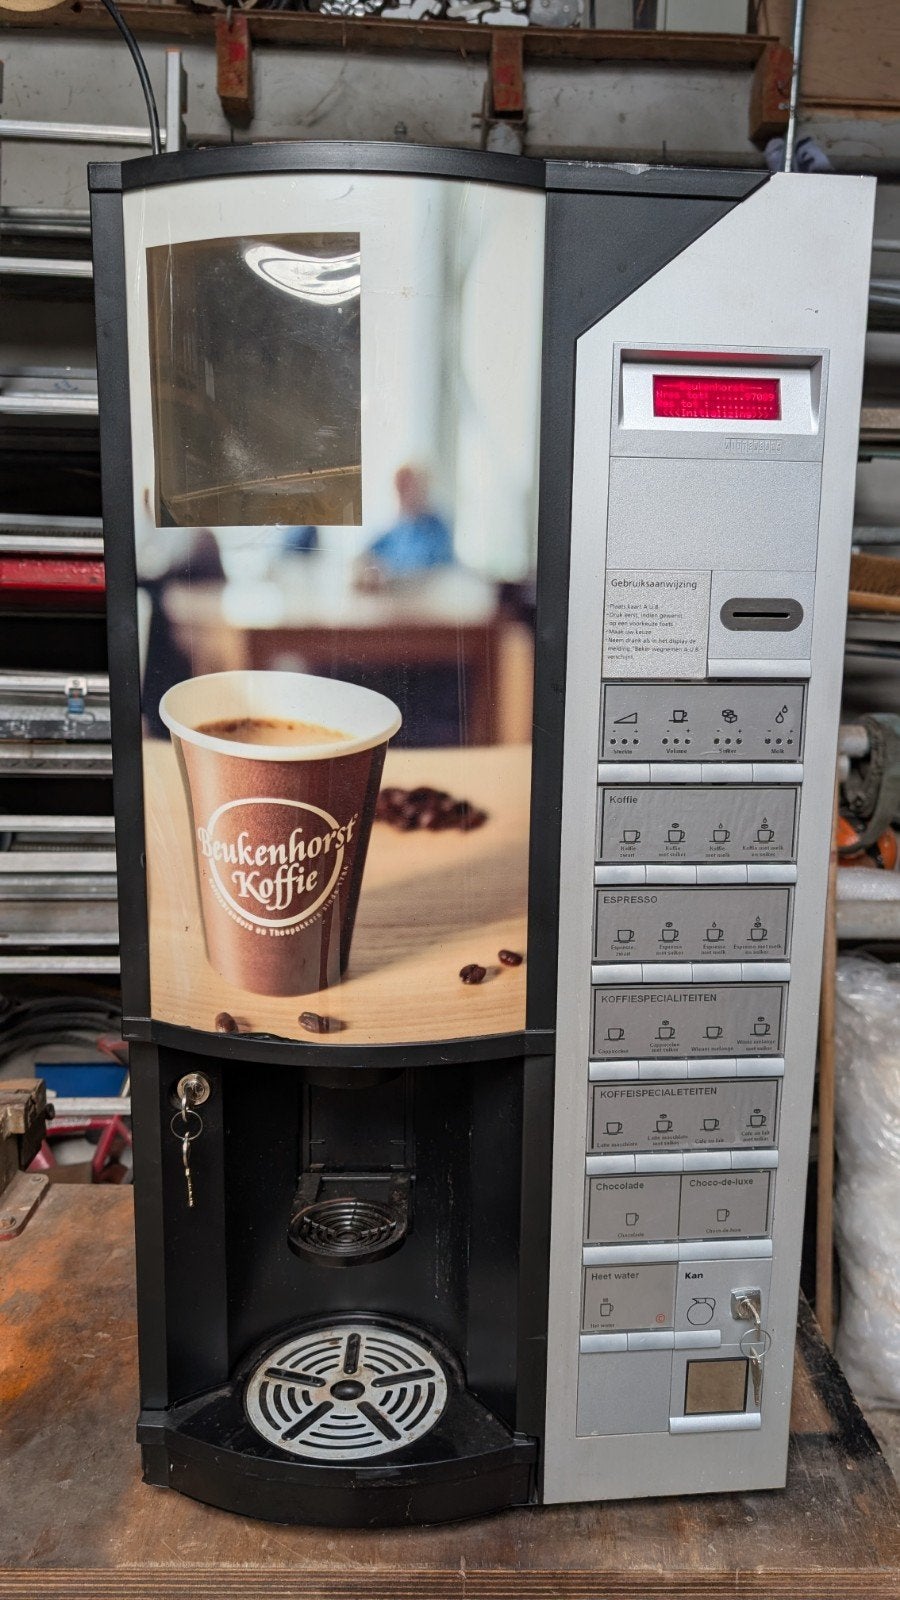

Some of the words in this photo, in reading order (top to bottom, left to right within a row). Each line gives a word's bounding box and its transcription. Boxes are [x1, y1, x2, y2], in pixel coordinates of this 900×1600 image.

[611, 578, 698, 590] Gebruiksaanwijzing
[609, 795, 638, 804] Koffie
[198, 815, 357, 866] Beukenhorst
[232, 862, 318, 910] Koffie
[603, 896, 658, 904] ESPRESSO
[601, 994, 717, 1004] KOFFIESPECIALITEITEN
[600, 1087, 717, 1098] KOFFEISPECIALETEITEN
[596, 1181, 644, 1191] Chocolade
[689, 1178, 753, 1187] Choco-de-luxe
